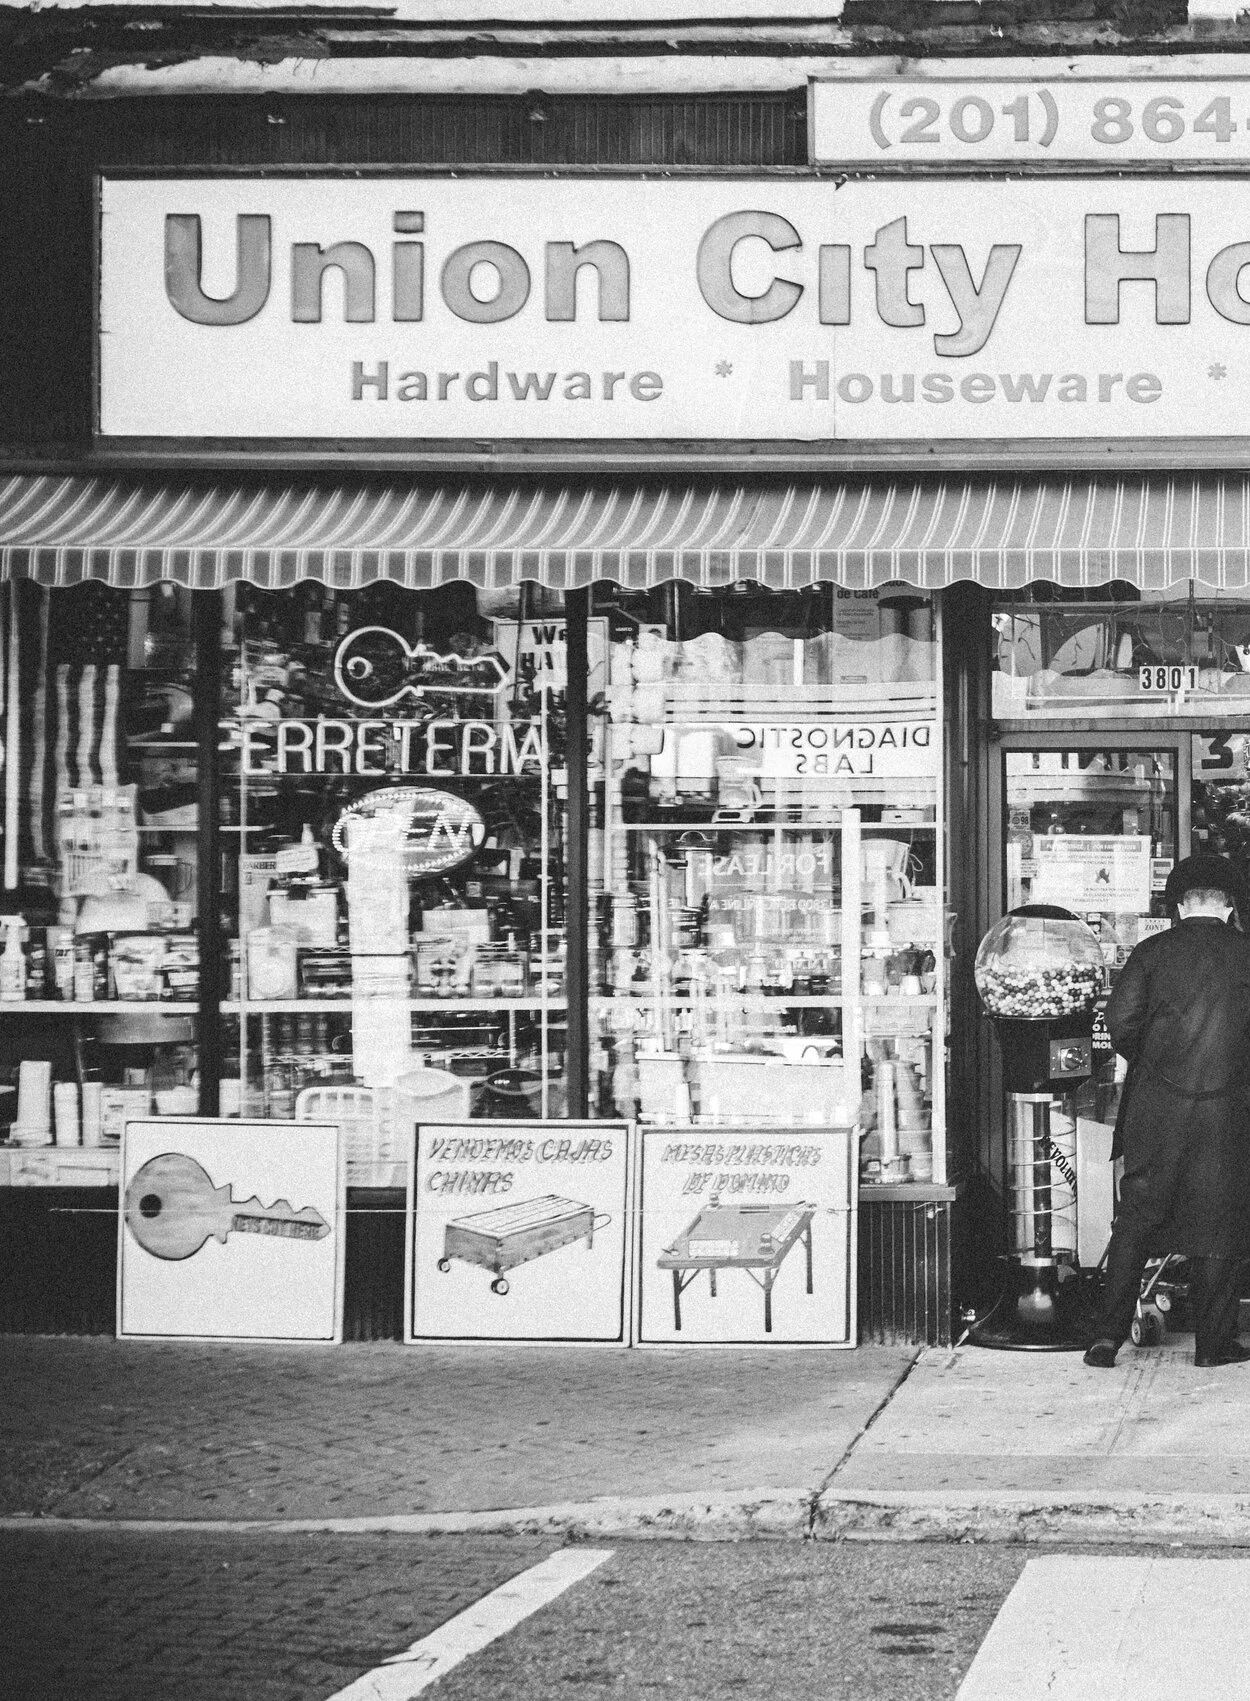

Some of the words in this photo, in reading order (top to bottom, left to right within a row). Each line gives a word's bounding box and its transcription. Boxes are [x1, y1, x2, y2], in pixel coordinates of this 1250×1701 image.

[869, 89, 1059, 150] (201)
[163, 209, 631, 327] Union
[696, 208, 1023, 358] City
[351, 361, 664, 402] Hardware
[789, 359, 1163, 404] Houseware
[1142, 667, 1195, 689] 3801
[429, 1138, 535, 1163] VENDEMOS
[536, 1138, 614, 1164] CAJAS
[426, 1170, 514, 1195] CHINAS
